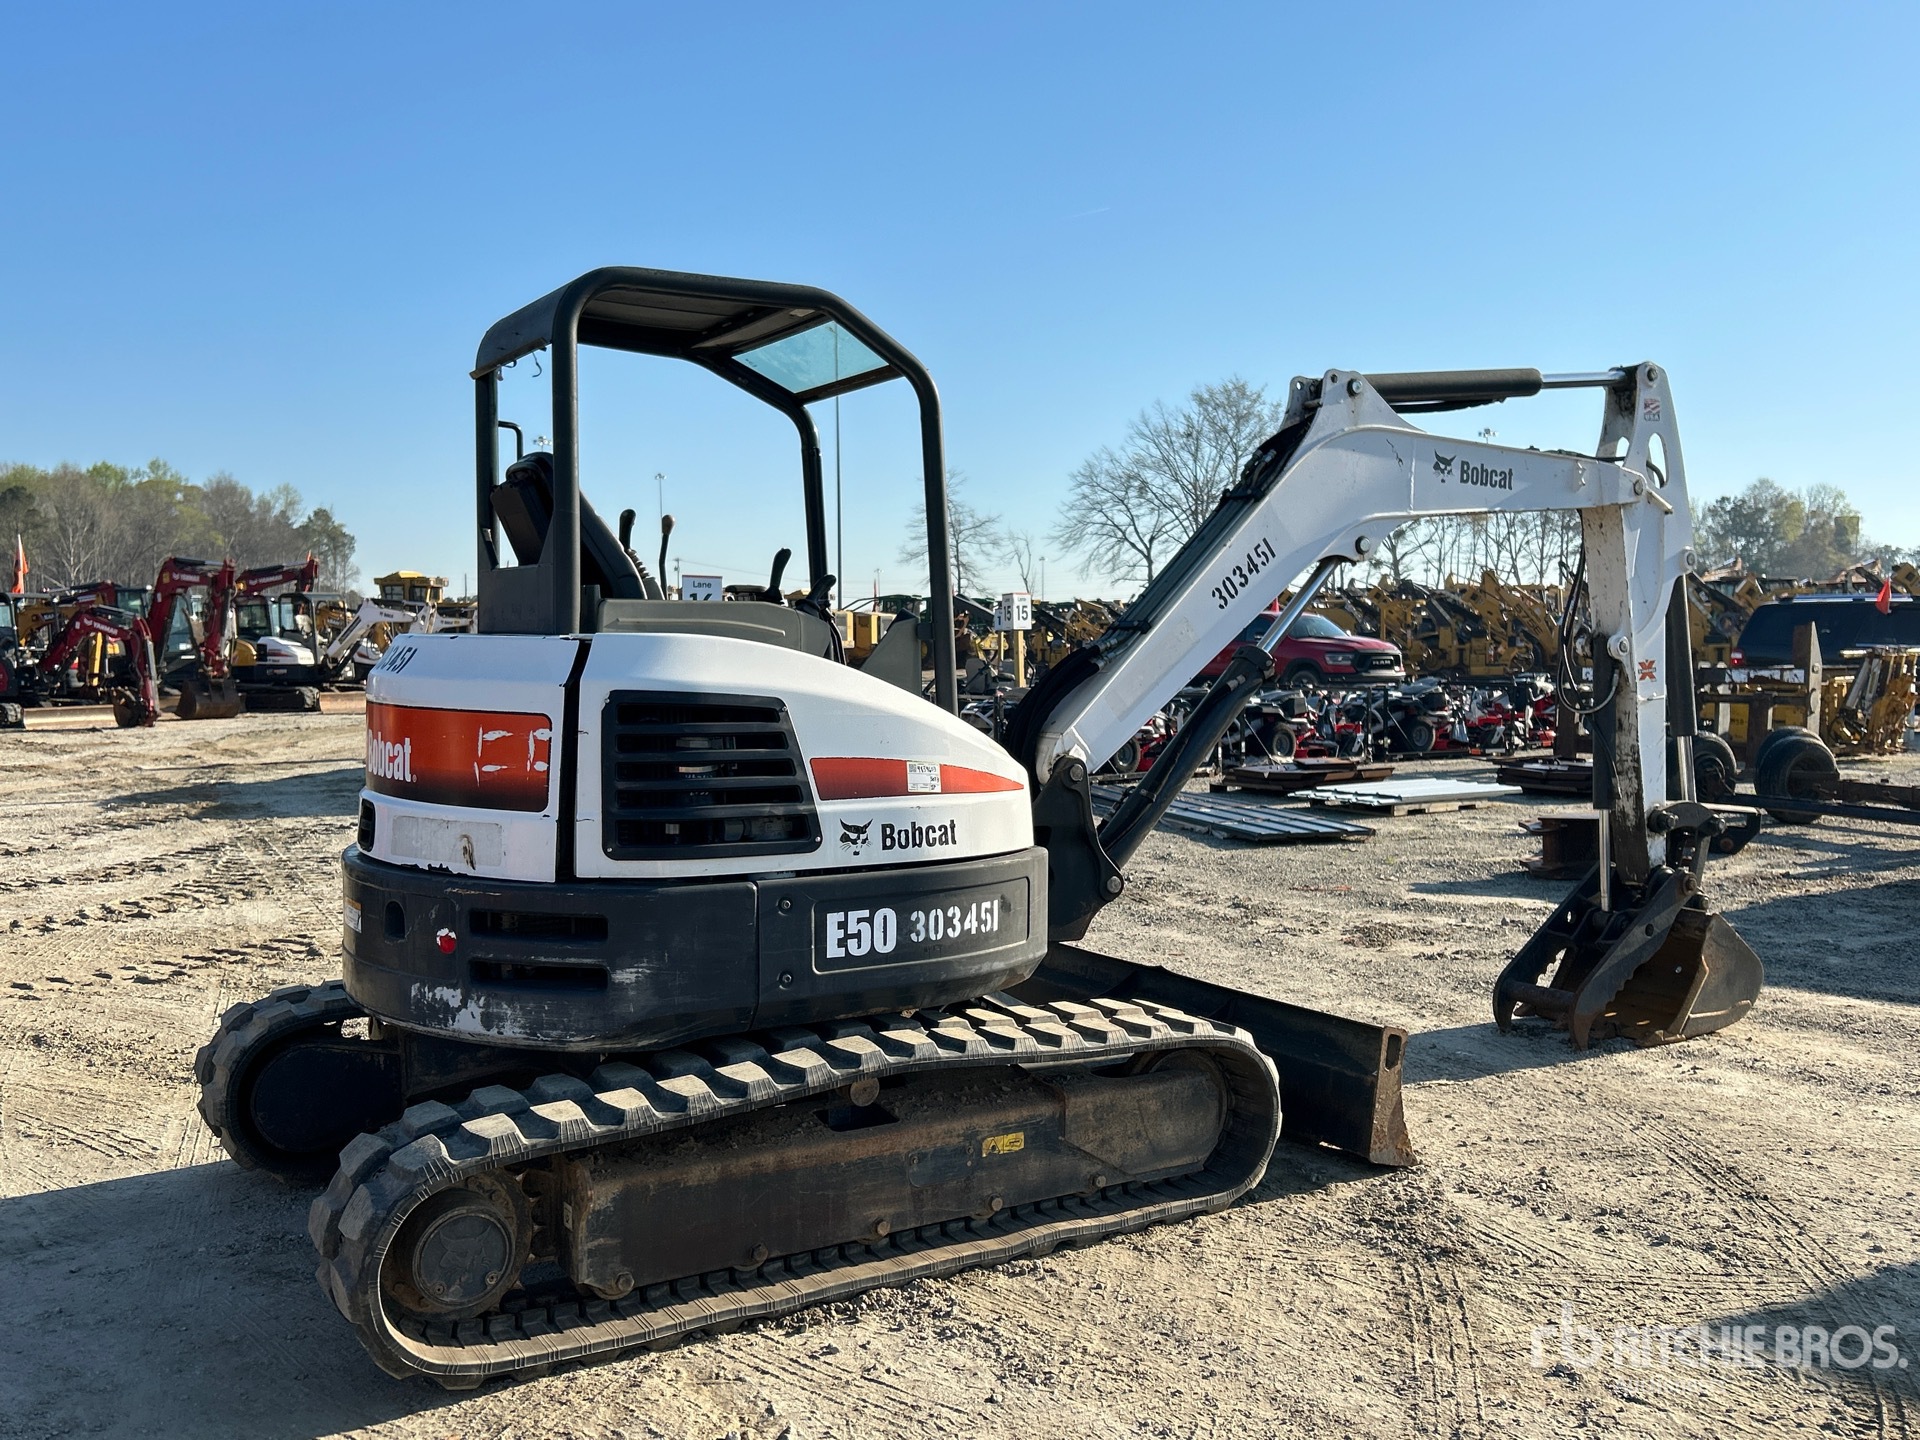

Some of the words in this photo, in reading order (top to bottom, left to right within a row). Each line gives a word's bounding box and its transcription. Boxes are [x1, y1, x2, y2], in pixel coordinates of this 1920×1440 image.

[1460, 460, 1513, 491] Bobcat
[692, 580, 712, 588] Lane
[1212, 537, 1276, 609] 303451
[93, 621, 118, 635] YANMAR
[1016, 605, 1029, 621] 15
[368, 729, 411, 783] Bobcat
[881, 819, 957, 851] Bobcat
[826, 907, 897, 959] E50
[910, 899, 999, 943] 303451
